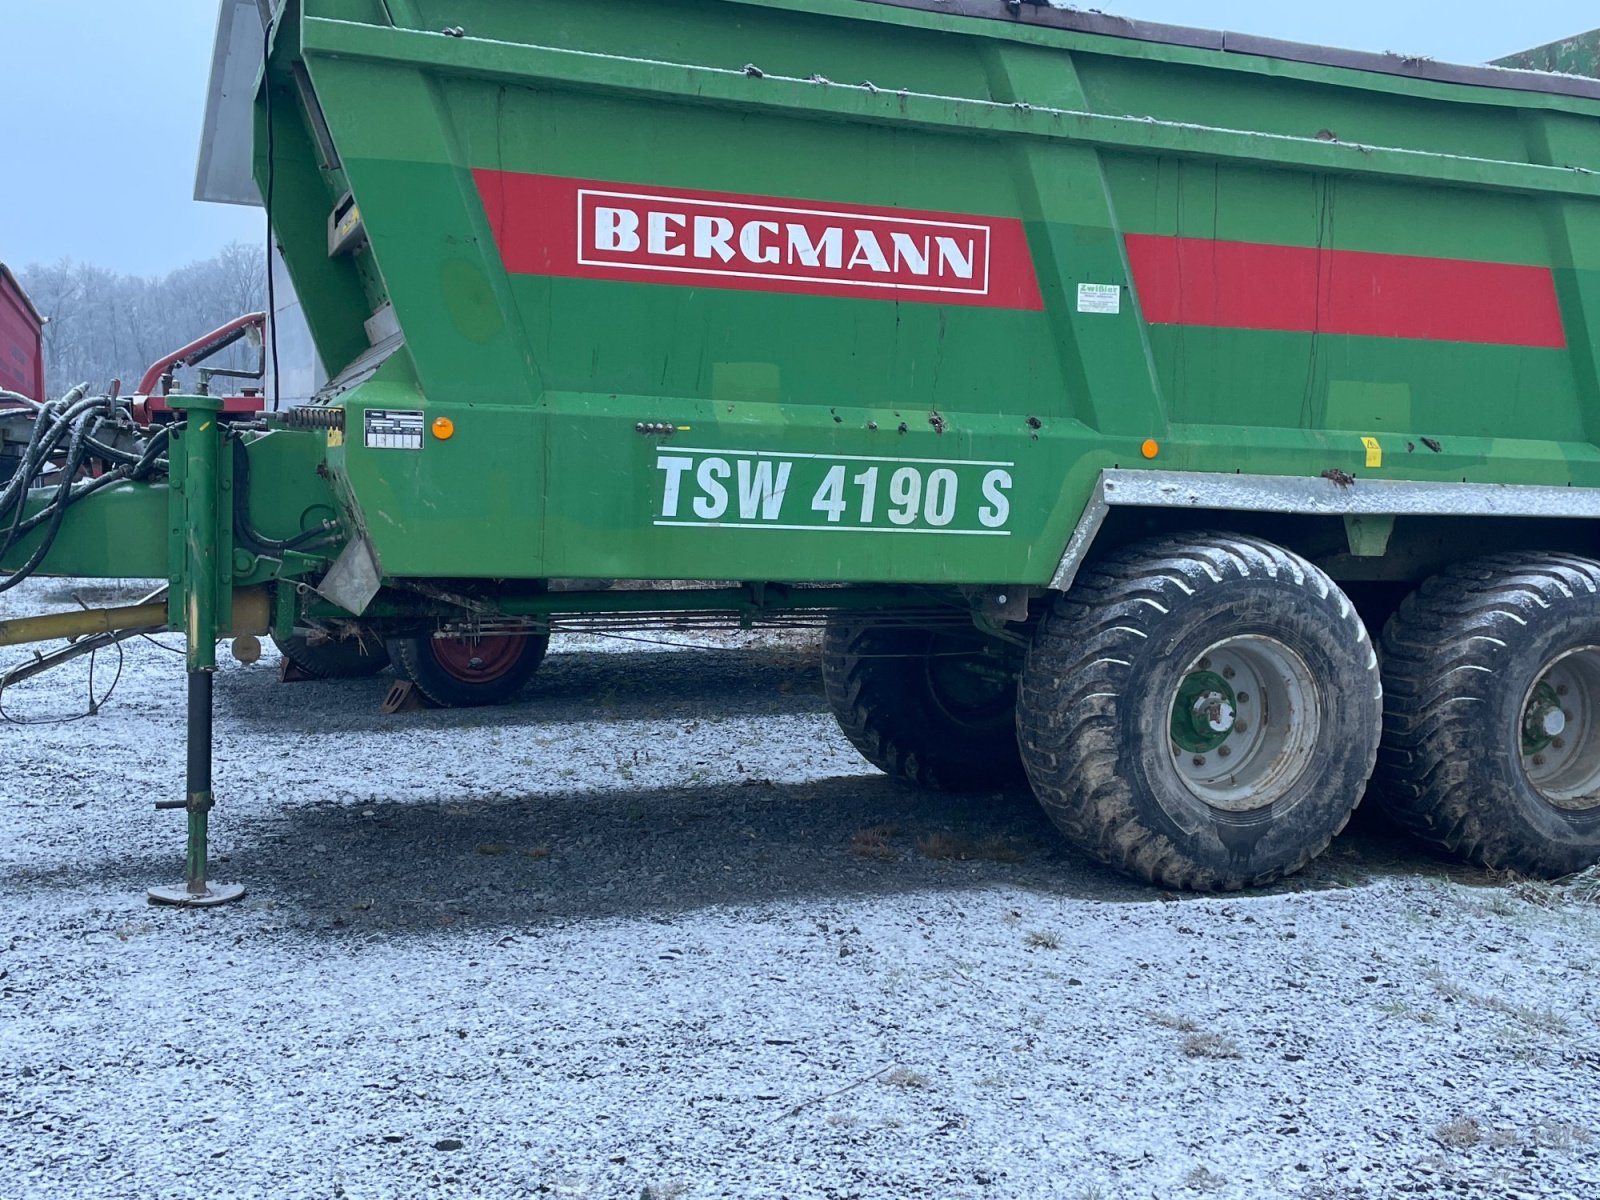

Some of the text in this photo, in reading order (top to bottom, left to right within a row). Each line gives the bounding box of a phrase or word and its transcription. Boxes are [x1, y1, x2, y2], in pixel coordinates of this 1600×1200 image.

[594, 206, 974, 279] BERGMANN
[656, 456, 1013, 528] TSW 4190 S
